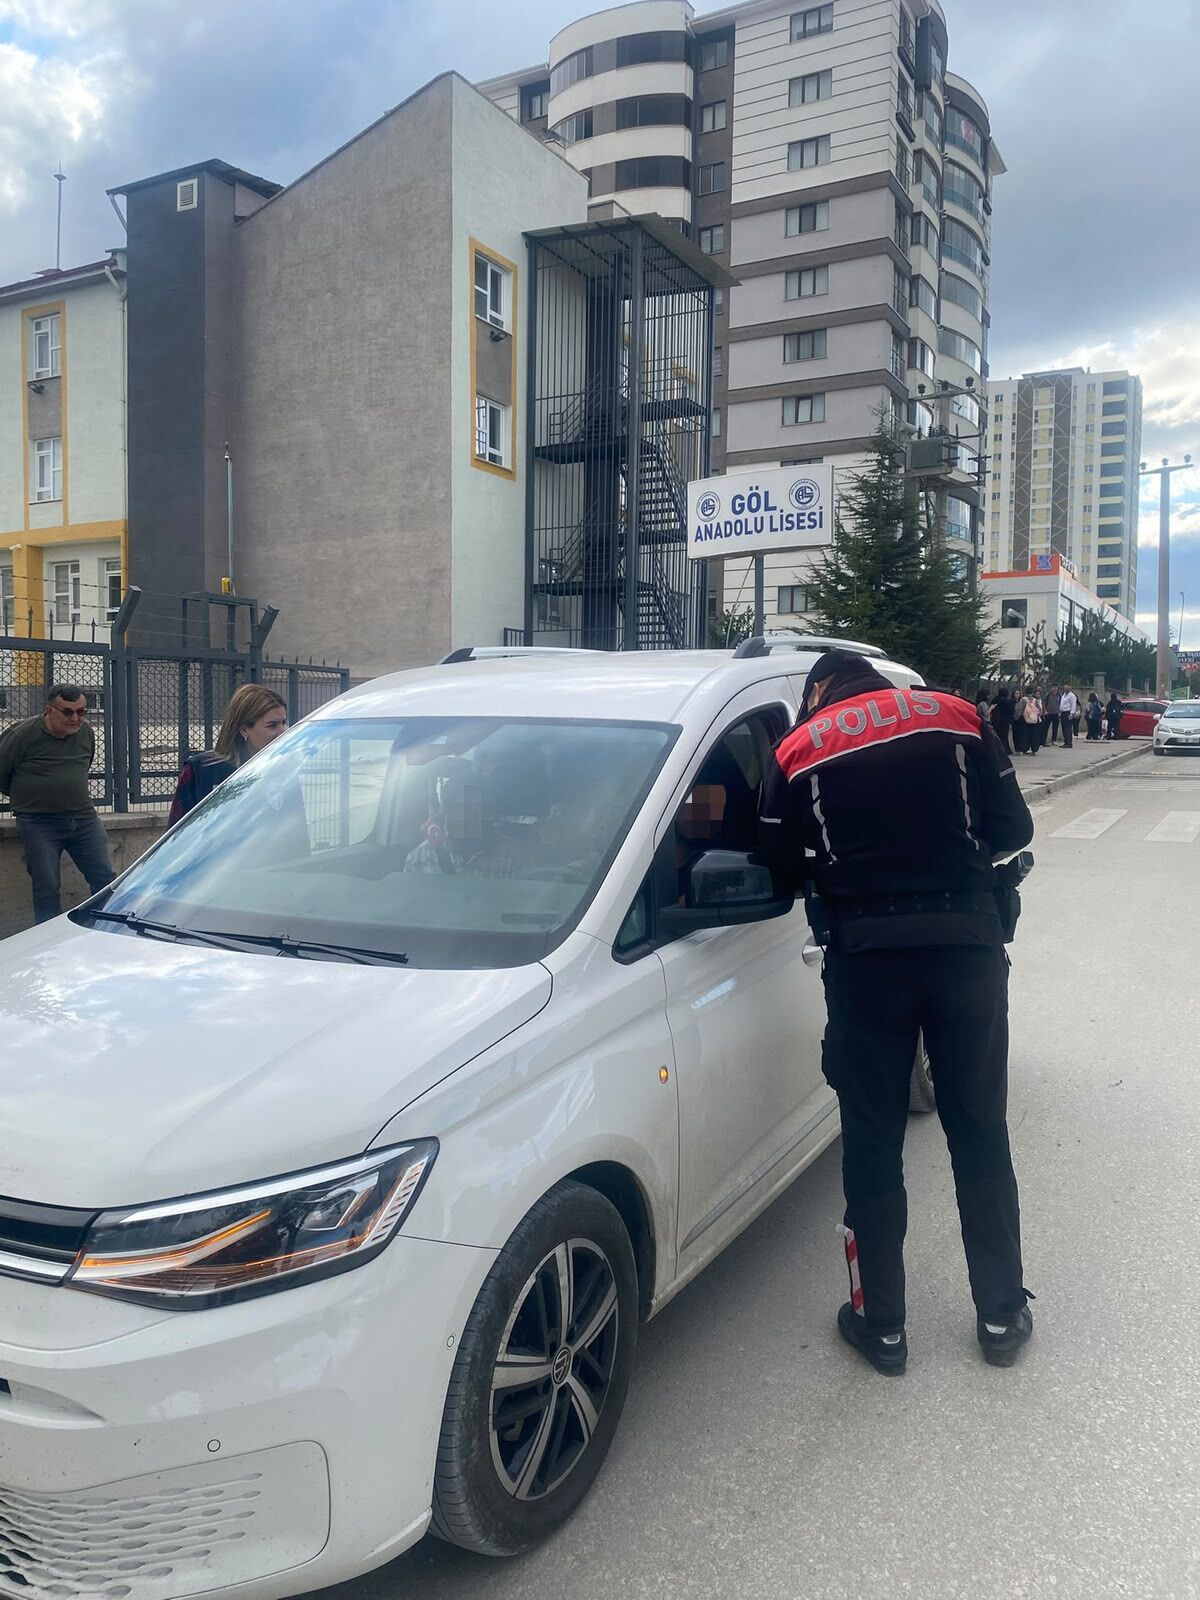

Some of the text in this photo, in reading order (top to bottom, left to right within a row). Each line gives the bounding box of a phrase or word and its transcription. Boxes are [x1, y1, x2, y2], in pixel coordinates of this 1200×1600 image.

[731, 485, 777, 515] GÖL
[694, 506, 824, 543] ANADOLU LİSESİ
